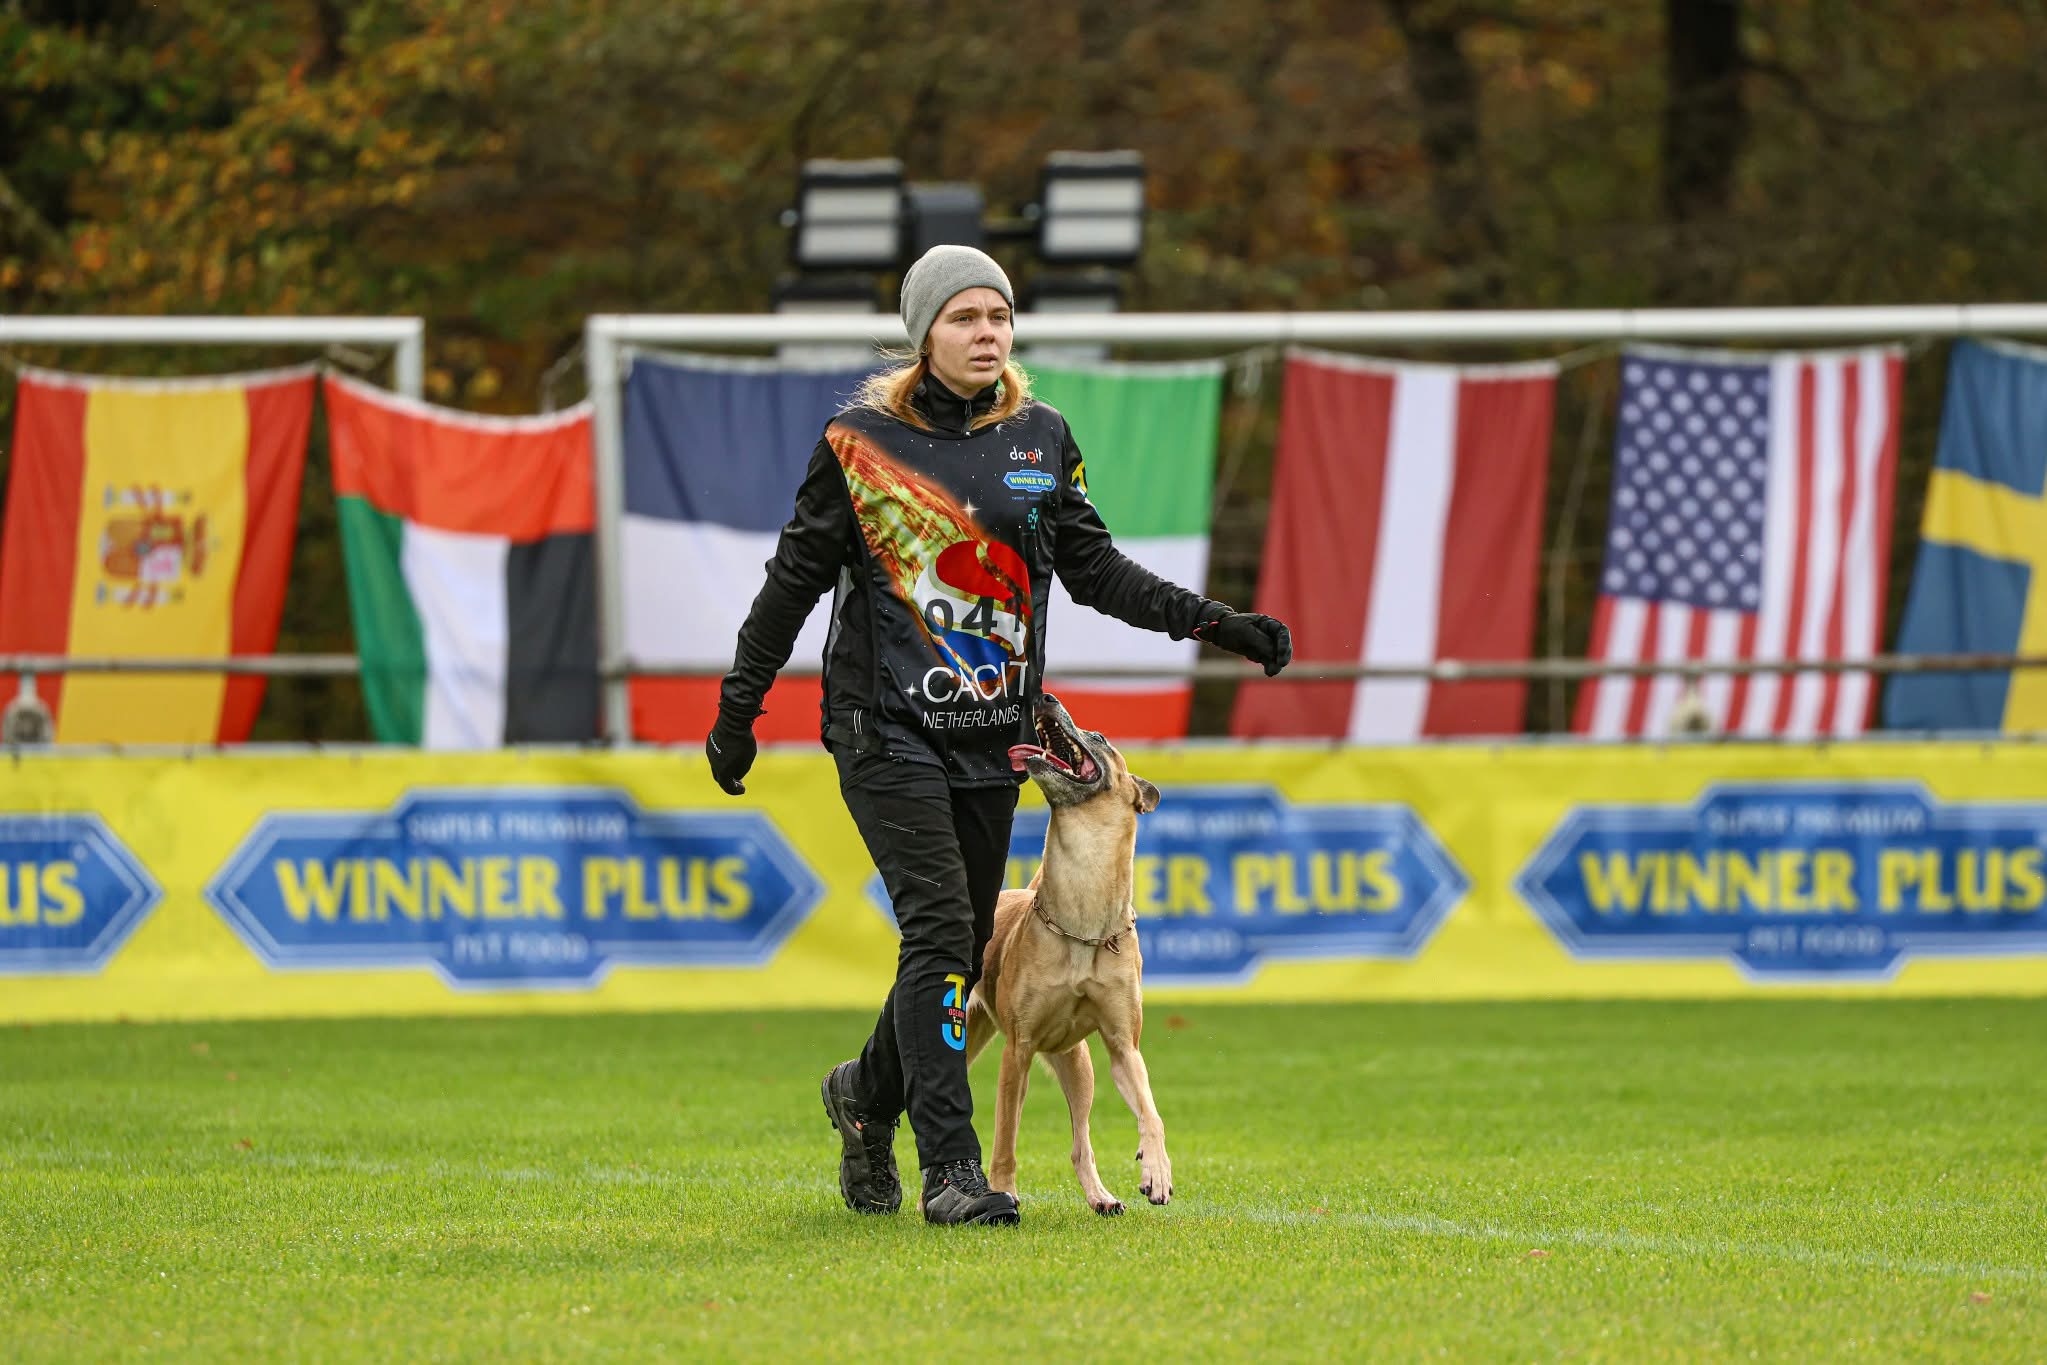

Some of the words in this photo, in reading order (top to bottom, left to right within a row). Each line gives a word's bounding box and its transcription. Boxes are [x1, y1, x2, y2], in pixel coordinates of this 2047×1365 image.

[1009, 476, 1037, 485] WINNER
[1037, 477, 1052, 487] PLUS
[922, 660, 1028, 703] CACIT
[274, 856, 564, 924] WINNER
[581, 854, 753, 921] PLUS
[1231, 850, 1403, 917] PLUS
[1578, 849, 1859, 916] WINNER
[1877, 847, 2047, 913] PLUS
